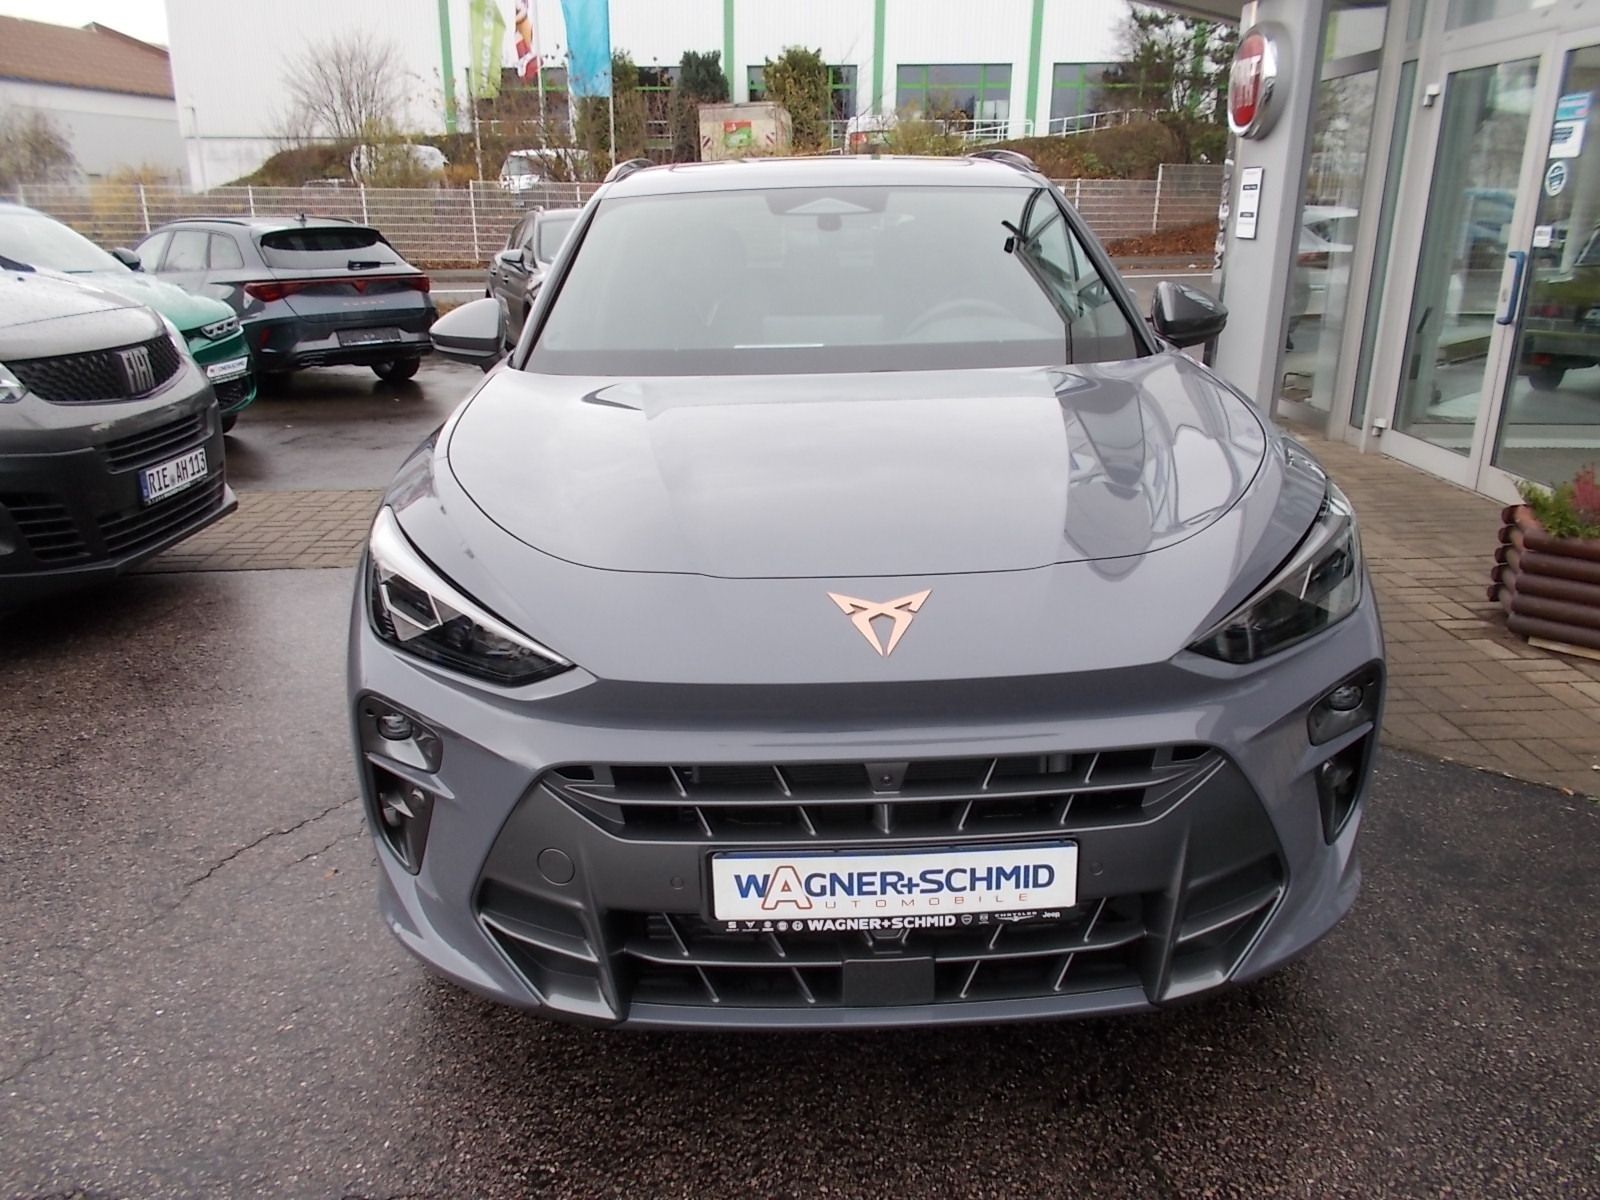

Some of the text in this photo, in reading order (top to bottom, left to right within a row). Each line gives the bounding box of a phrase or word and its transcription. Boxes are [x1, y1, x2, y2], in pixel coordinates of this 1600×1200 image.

[120, 346, 154, 393] FIAT
[148, 467, 170, 494] RIE
[734, 865, 1055, 910] WAGNER+SCHMID
[807, 913, 956, 932] WAGNER+SCHMID
